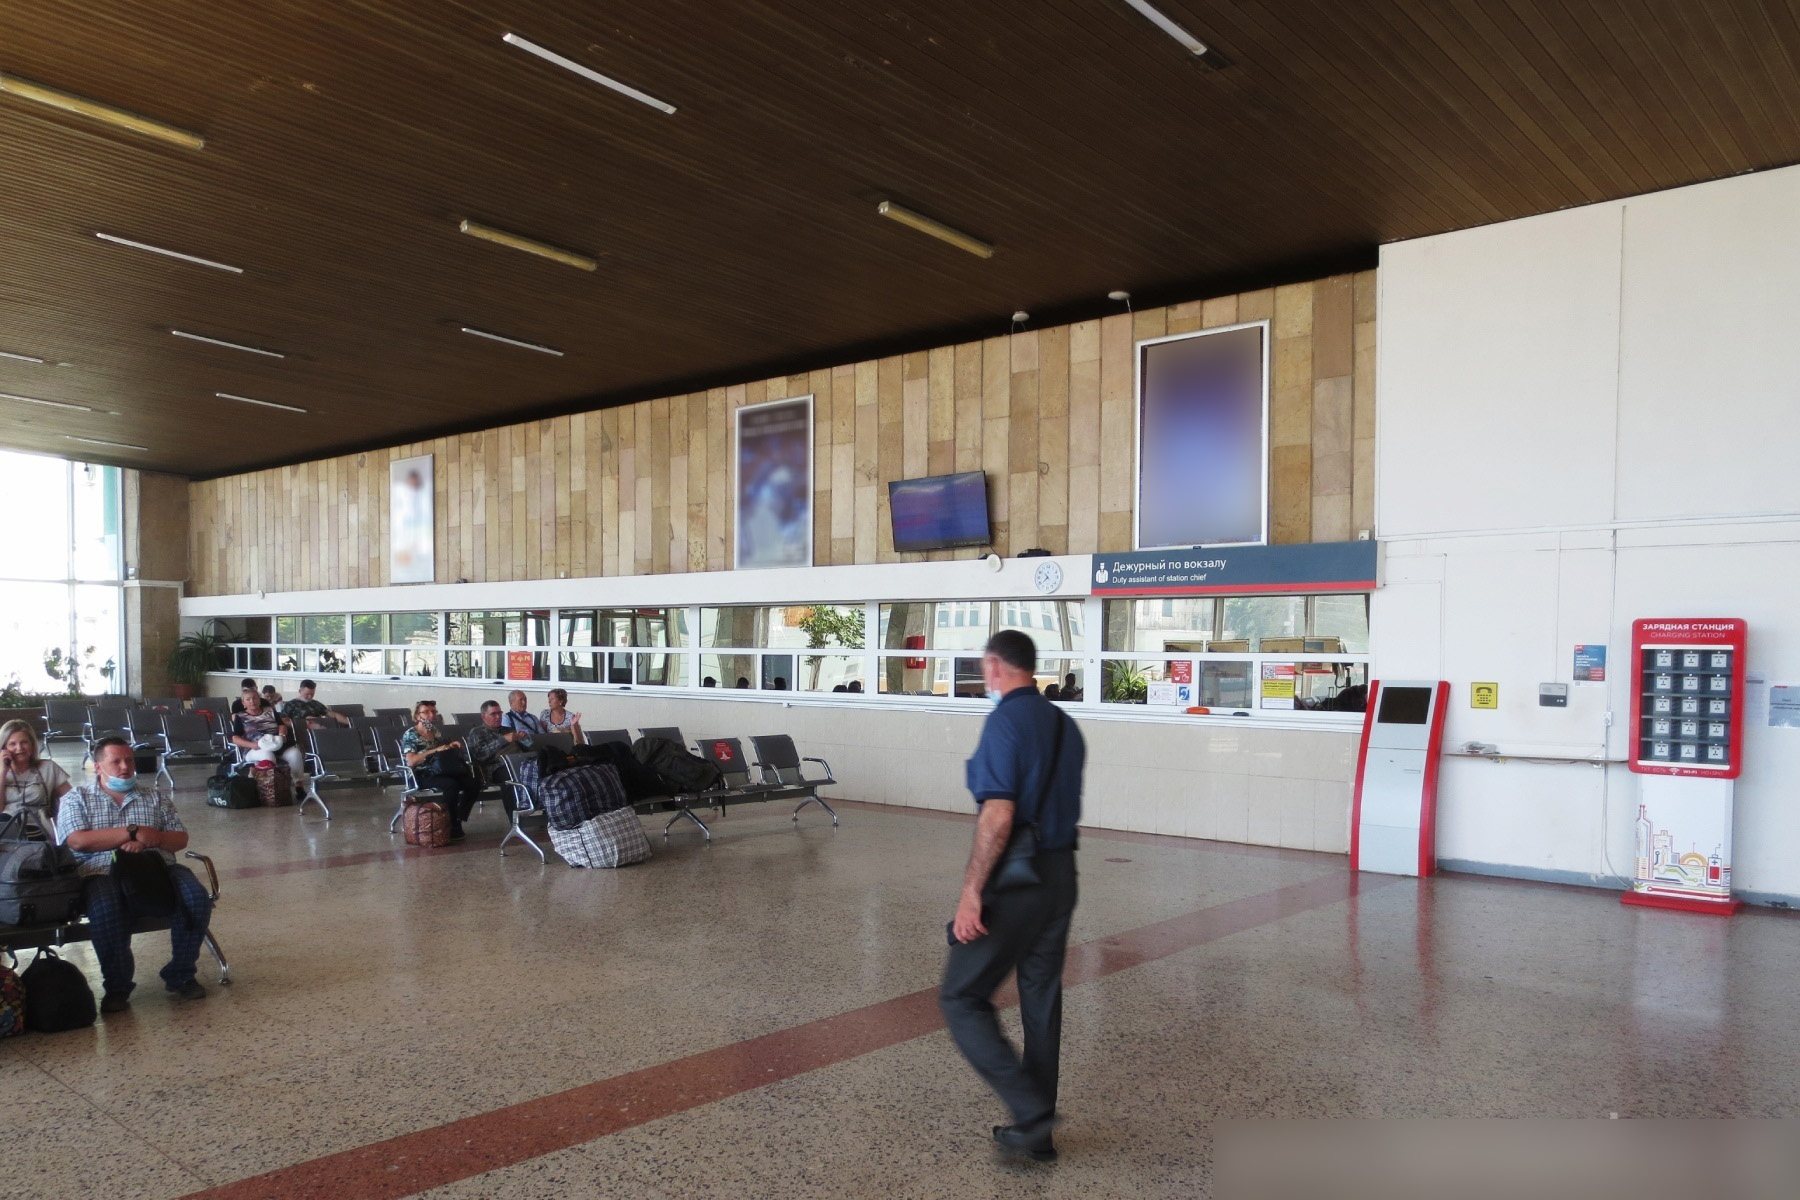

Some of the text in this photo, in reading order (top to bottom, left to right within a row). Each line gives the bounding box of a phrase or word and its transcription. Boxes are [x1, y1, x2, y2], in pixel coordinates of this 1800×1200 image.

[1112, 559, 1227, 573] Дежурный по вокзалу
[1112, 576, 1127, 585] Duty
[1128, 574, 1157, 583] assistant
